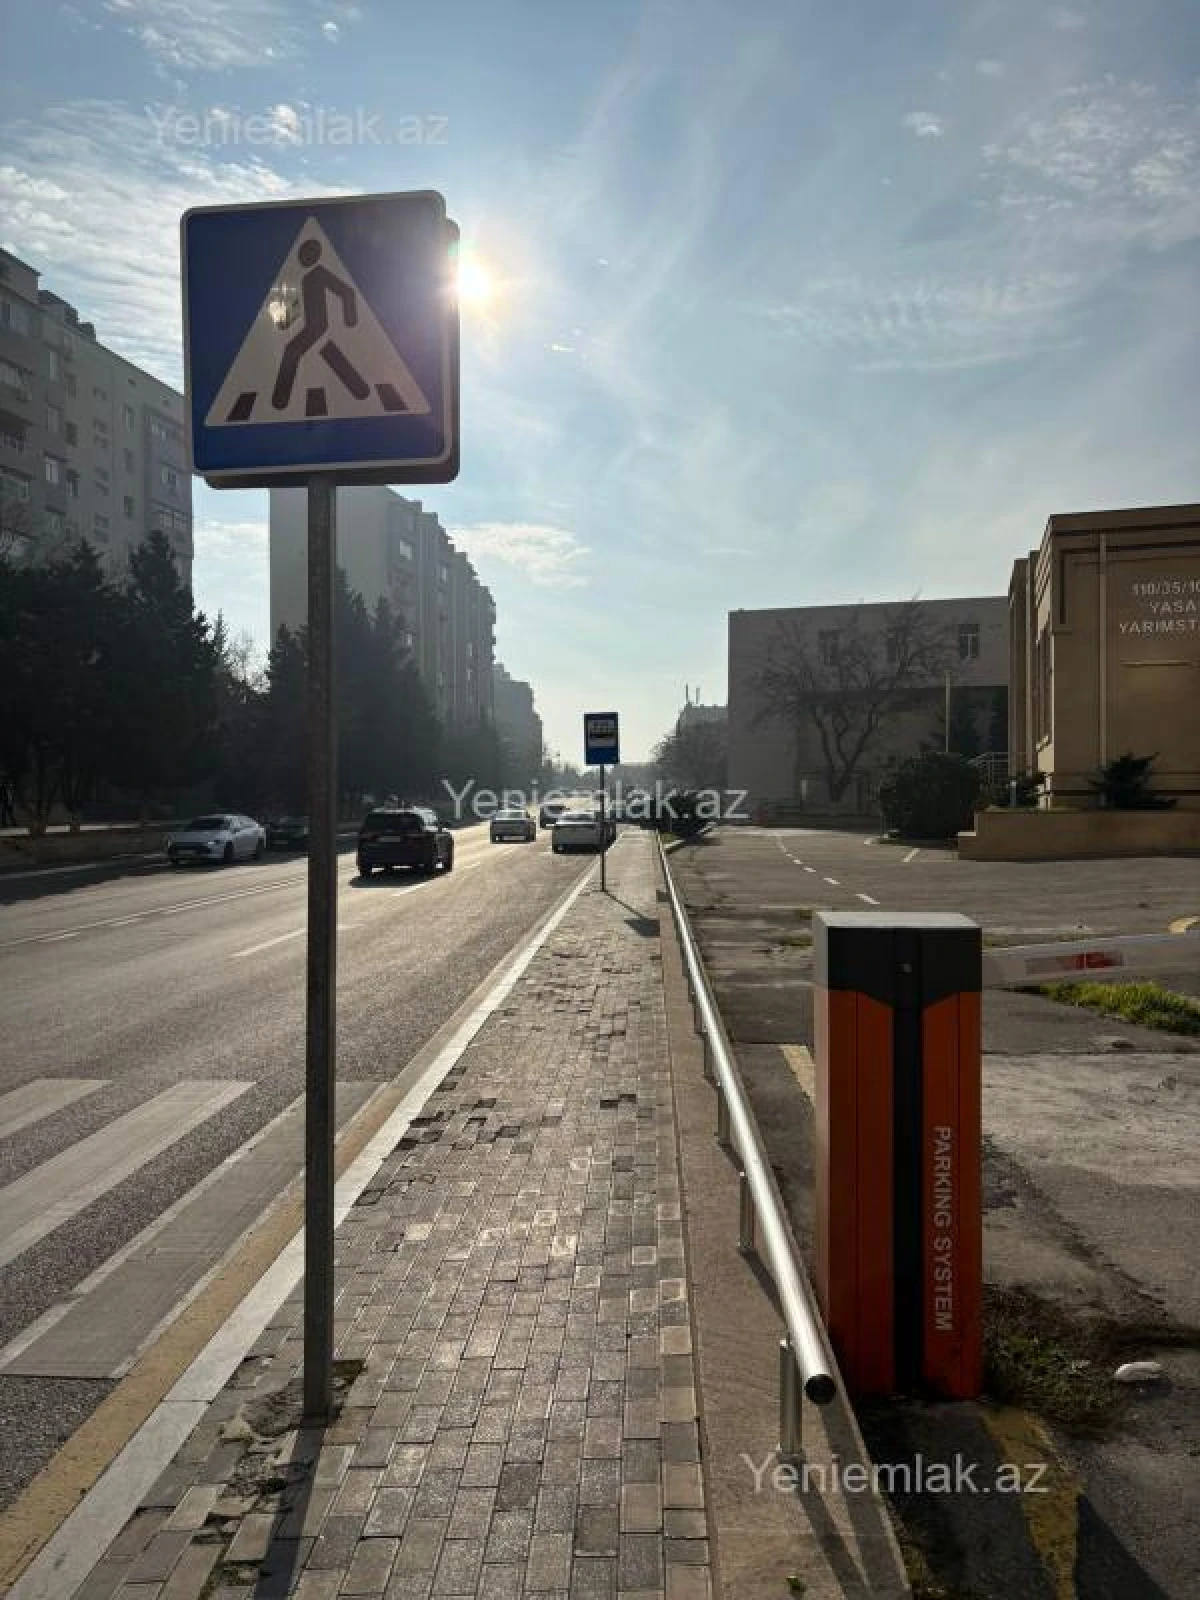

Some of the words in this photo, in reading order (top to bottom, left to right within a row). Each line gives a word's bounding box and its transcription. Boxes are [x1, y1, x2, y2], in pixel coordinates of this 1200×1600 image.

[1119, 619, 1200, 633] YARIMST
[933, 1125, 953, 1227] PARKING
[933, 1237, 954, 1331] SYSTEM
